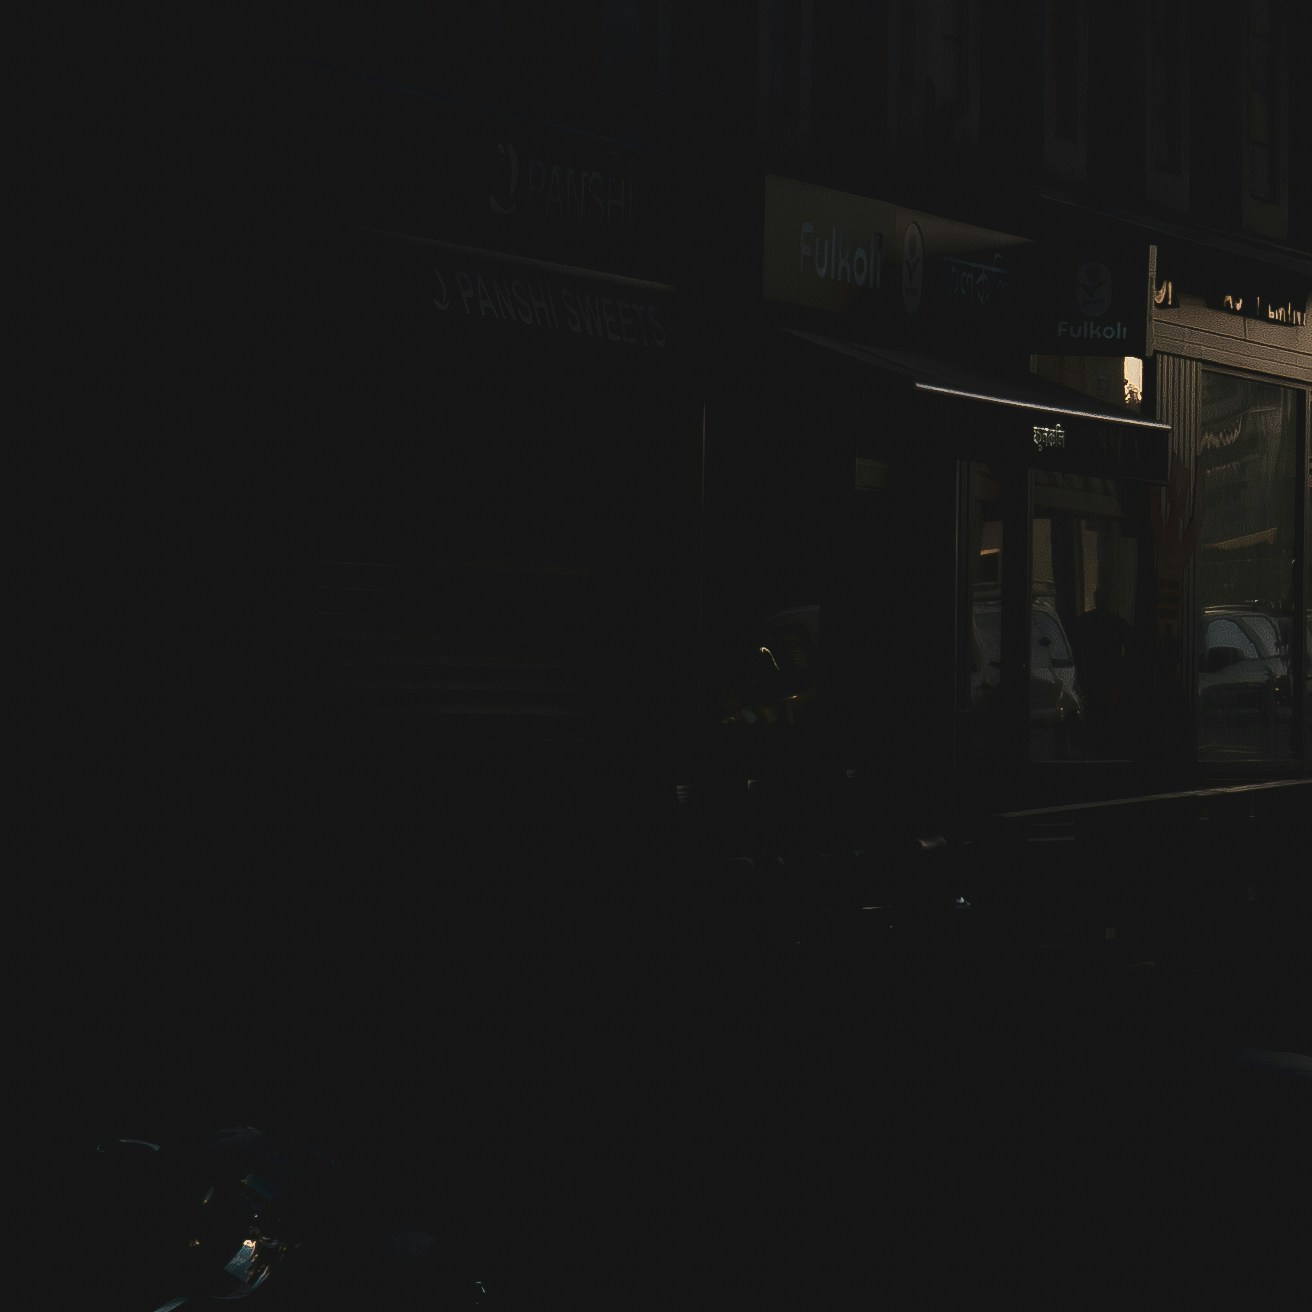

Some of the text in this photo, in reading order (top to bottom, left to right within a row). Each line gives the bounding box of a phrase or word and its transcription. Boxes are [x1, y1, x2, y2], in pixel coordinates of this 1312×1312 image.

[528, 158, 633, 227] PANSHI
[454, 269, 667, 348] PANSHI SWEETS
